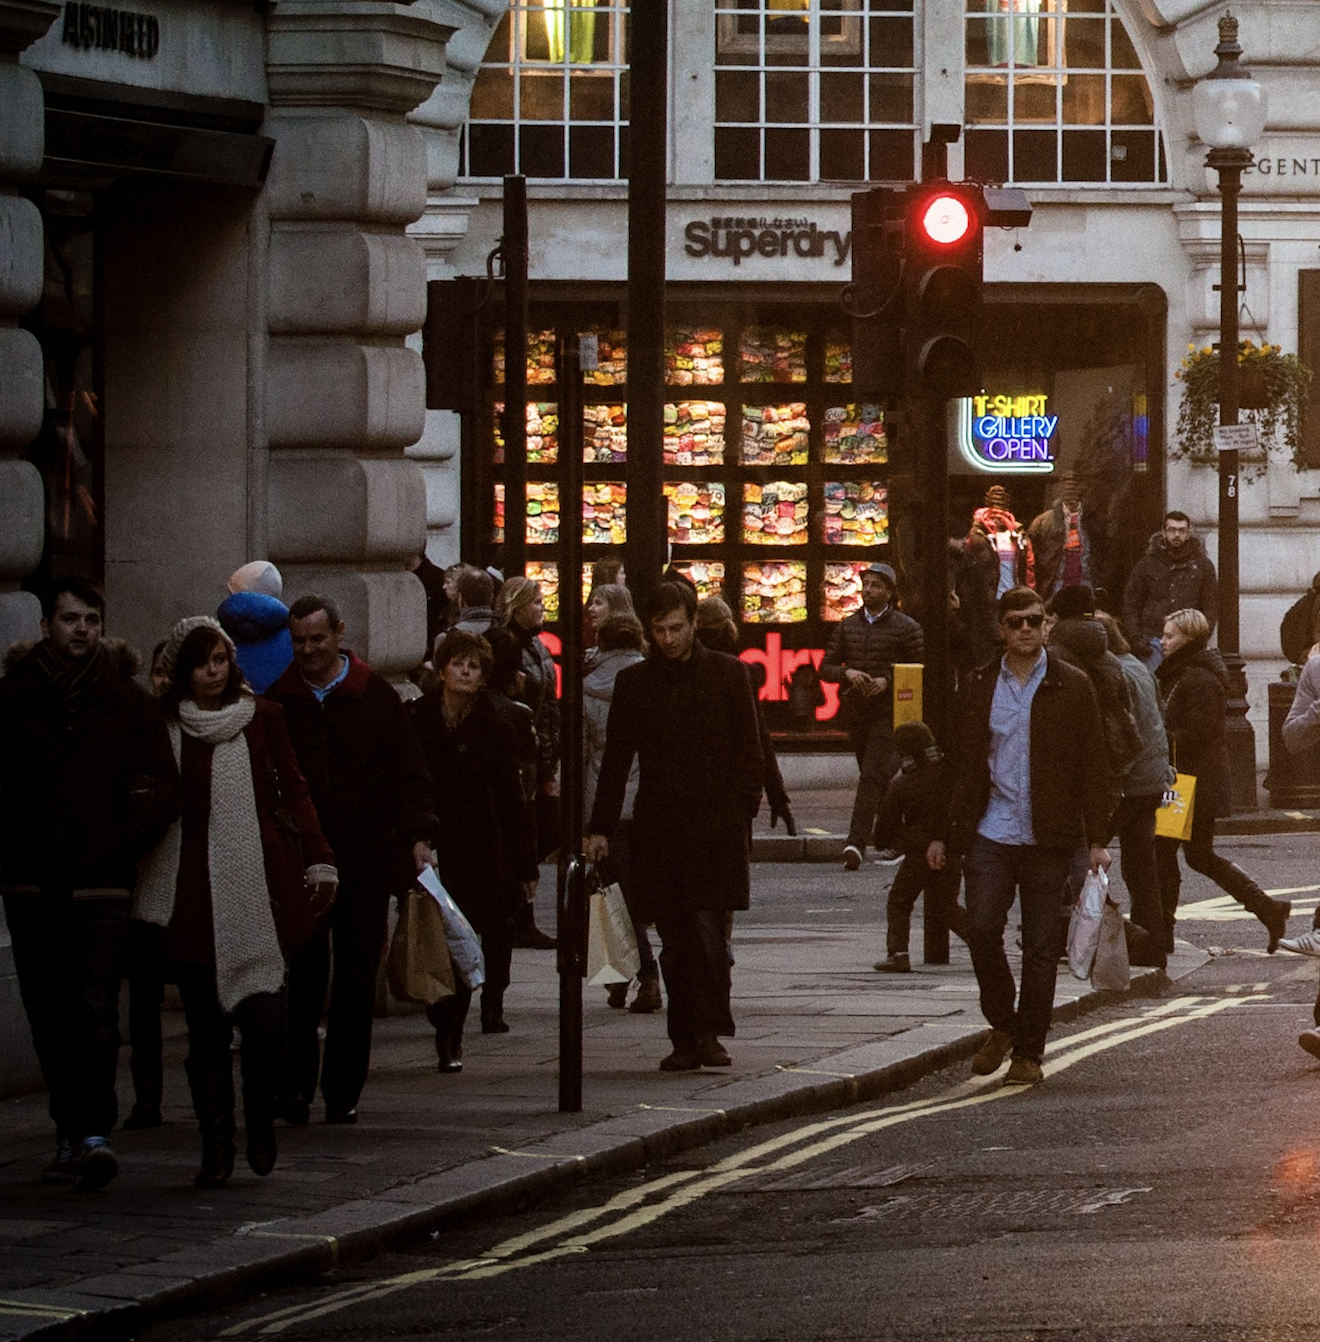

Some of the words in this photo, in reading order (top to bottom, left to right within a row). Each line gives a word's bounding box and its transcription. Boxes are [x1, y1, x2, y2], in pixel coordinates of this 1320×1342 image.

[685, 220, 852, 266] Superdry
[974, 395, 1048, 417] T-SHIRT
[979, 416, 1058, 438] GALLERY
